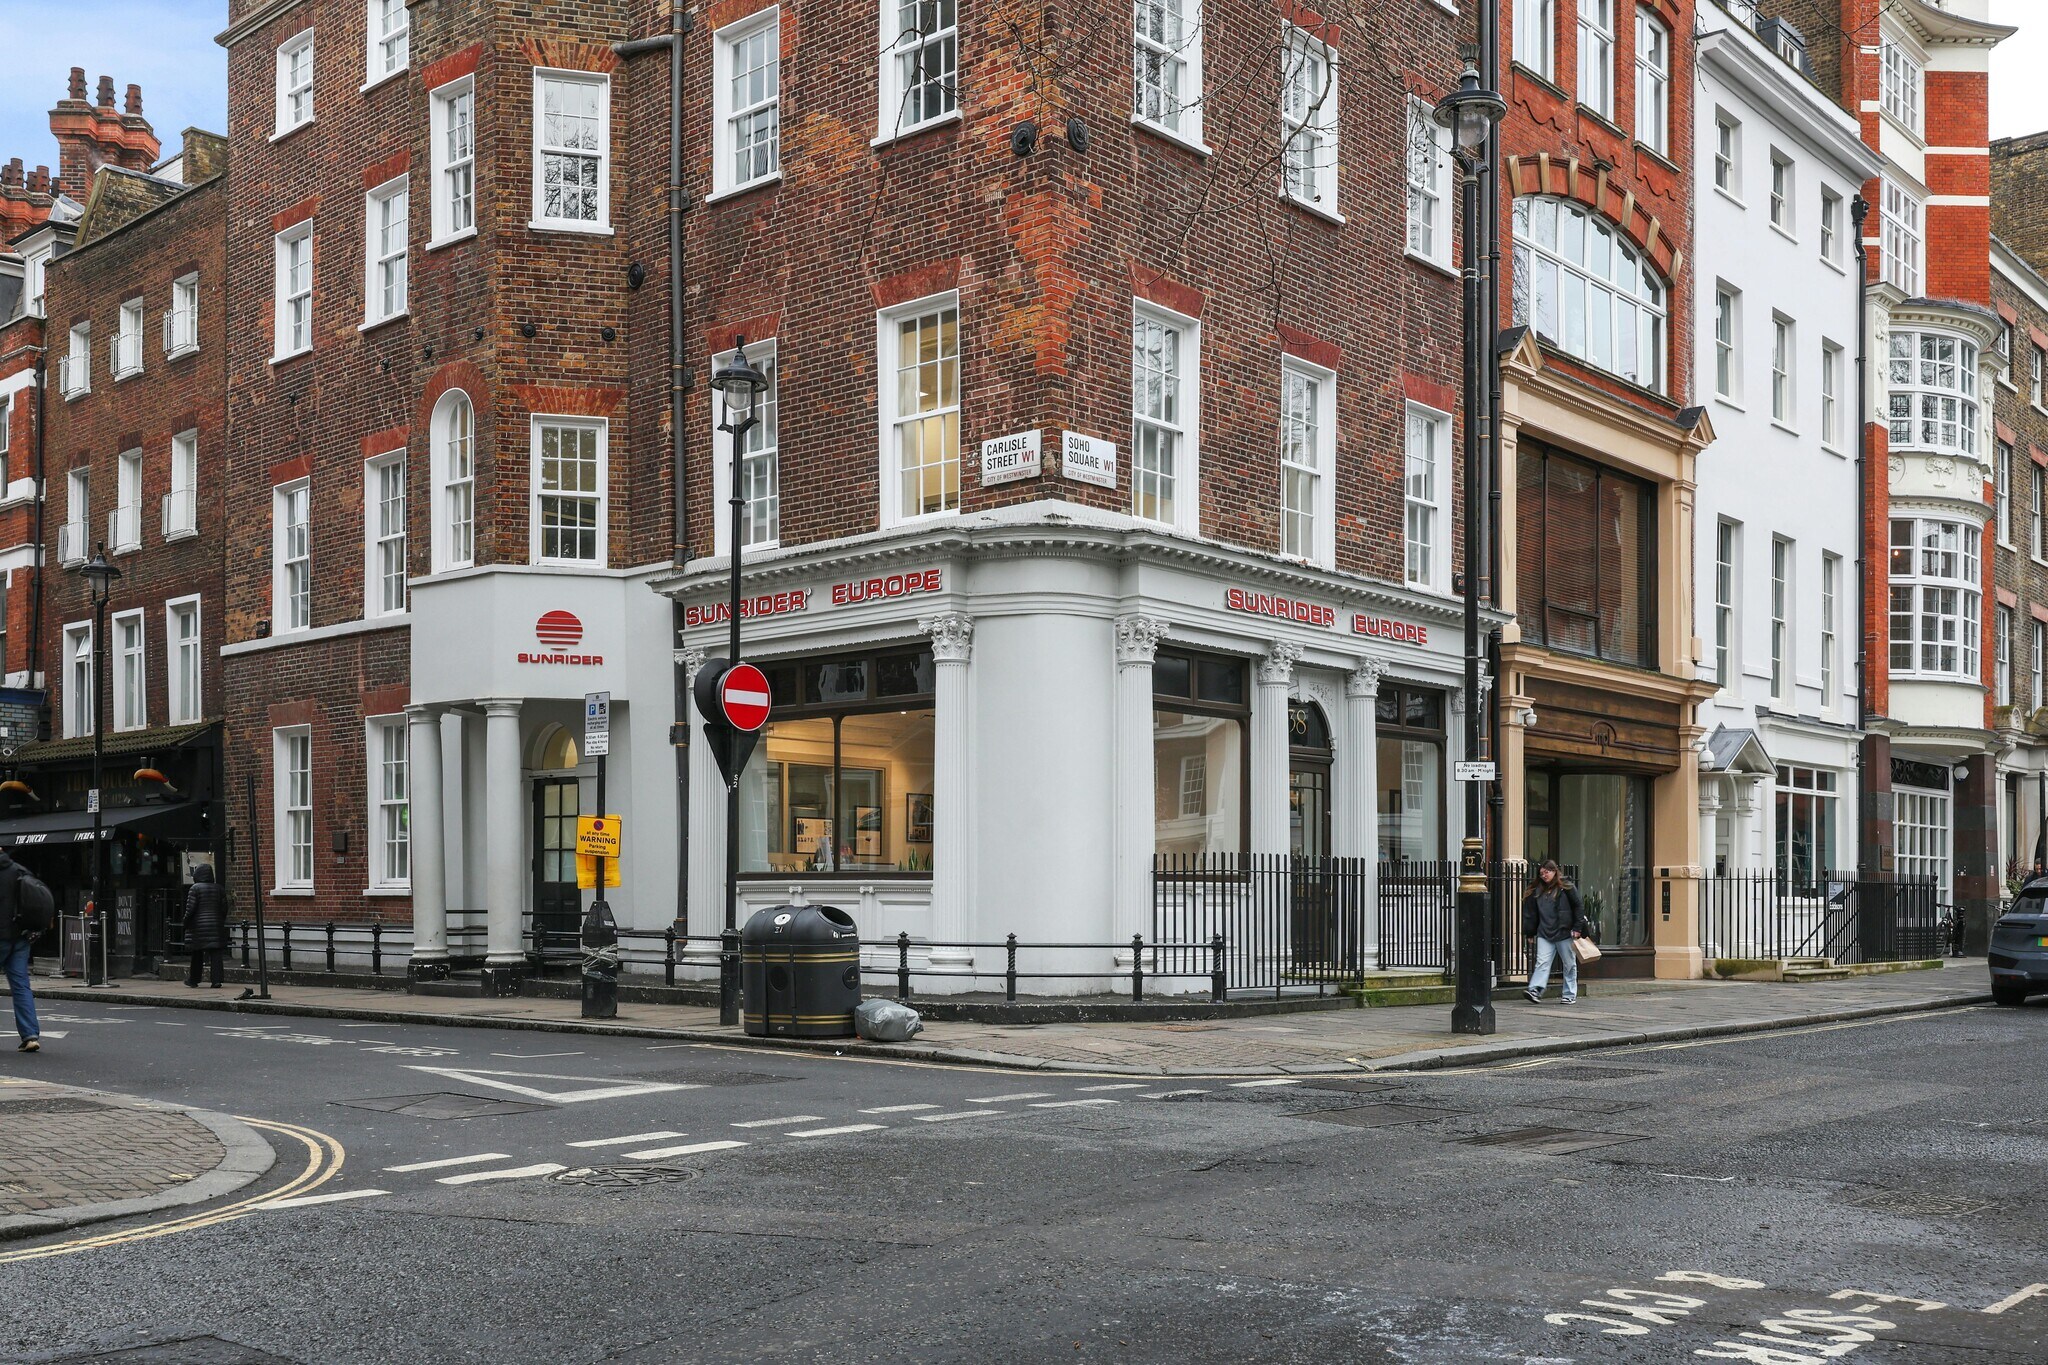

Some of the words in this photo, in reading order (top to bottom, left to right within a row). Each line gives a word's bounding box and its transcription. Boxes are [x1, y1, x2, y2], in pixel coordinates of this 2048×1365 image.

[987, 437, 1027, 456] CARLISLE
[1068, 437, 1090, 453] SOHO
[987, 453, 1018, 470] STREET
[1021, 450, 1035, 463] W1
[1068, 451, 1099, 469] SQUARE
[1103, 460, 1114, 473] W1
[1003, 469, 1032, 480] WESTMINSTER
[1082, 472, 1107, 484] WESTMINSTER
[686, 590, 806, 626] SUNRIDER
[832, 568, 942, 605] EUROPE
[1227, 588, 1335, 627] SUNRIDER
[1353, 613, 1428, 644] EUROPE
[517, 653, 604, 666] SUNRIDER
[1288, 709, 1306, 734] 38
[580, 835, 617, 844] WARNING
[118, 896, 133, 907] DON'T
[116, 908, 132, 920] WORRY
[117, 921, 132, 935] DRINK
